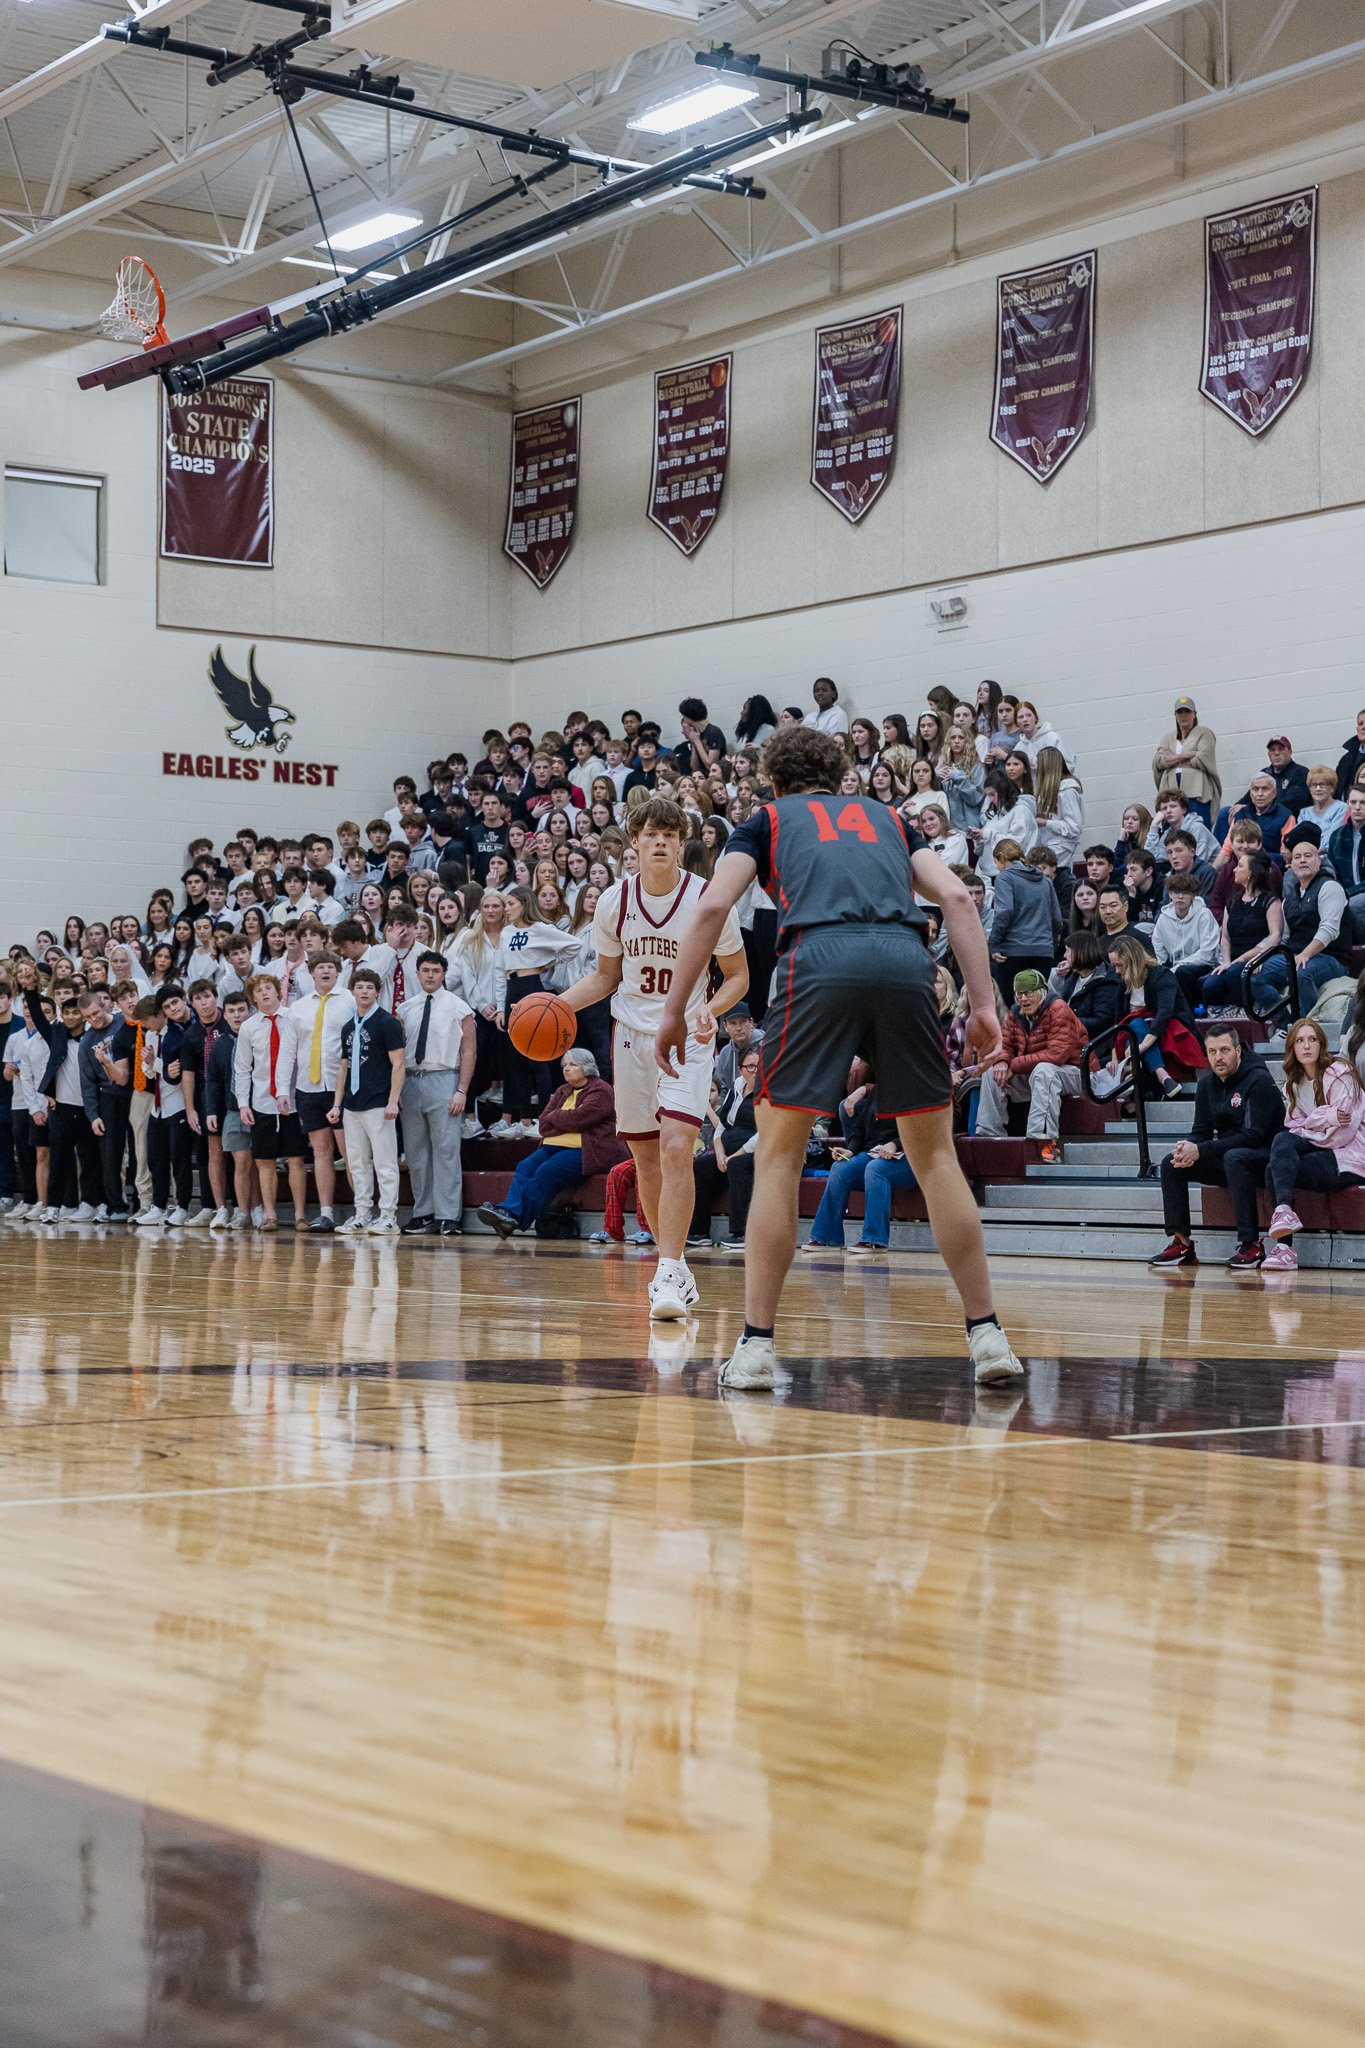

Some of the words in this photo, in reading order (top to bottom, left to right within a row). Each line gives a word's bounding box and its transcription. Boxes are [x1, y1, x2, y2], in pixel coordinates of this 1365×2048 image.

[1243, 220, 1284, 245] COUNTRY
[658, 378, 710, 401] BASKETBALL
[186, 411, 251, 440] STATE
[167, 432, 269, 464] CHAMPIONS
[170, 454, 216, 475] 2025
[162, 752, 267, 781] EAGLES'
[273, 760, 339, 787] NEST
[807, 801, 879, 843] 14
[625, 935, 680, 960] WATTERS
[640, 966, 673, 995] 30
